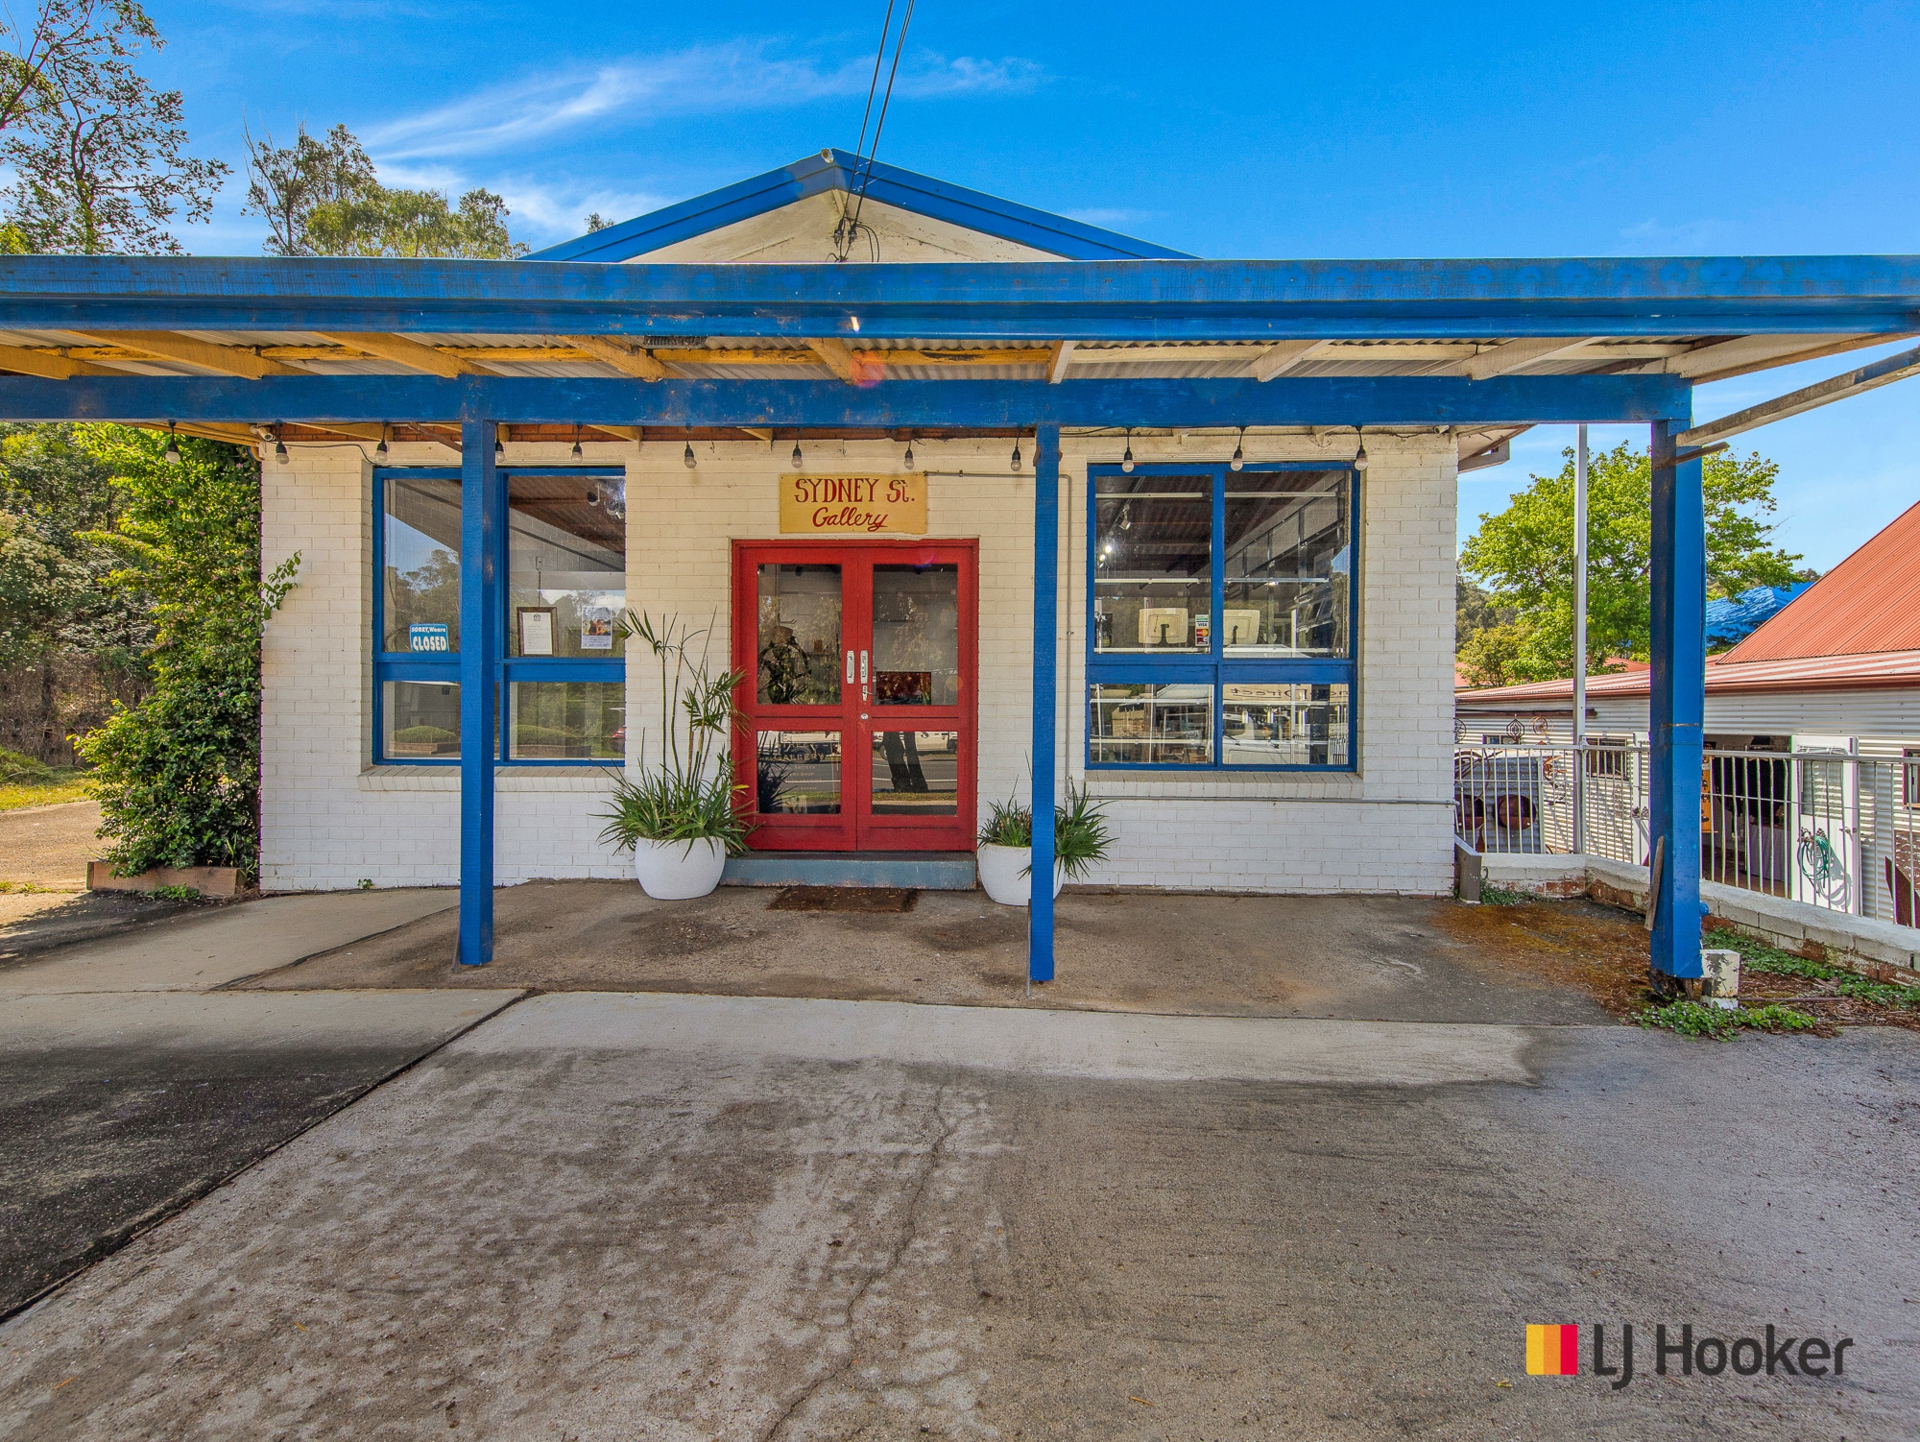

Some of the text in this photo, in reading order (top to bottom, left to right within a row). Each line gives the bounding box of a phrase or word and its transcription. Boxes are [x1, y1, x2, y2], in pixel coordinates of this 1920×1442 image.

[794, 478, 880, 503] SYDNEY
[812, 506, 888, 532] Gallery
[413, 636, 446, 651] CLOSED
